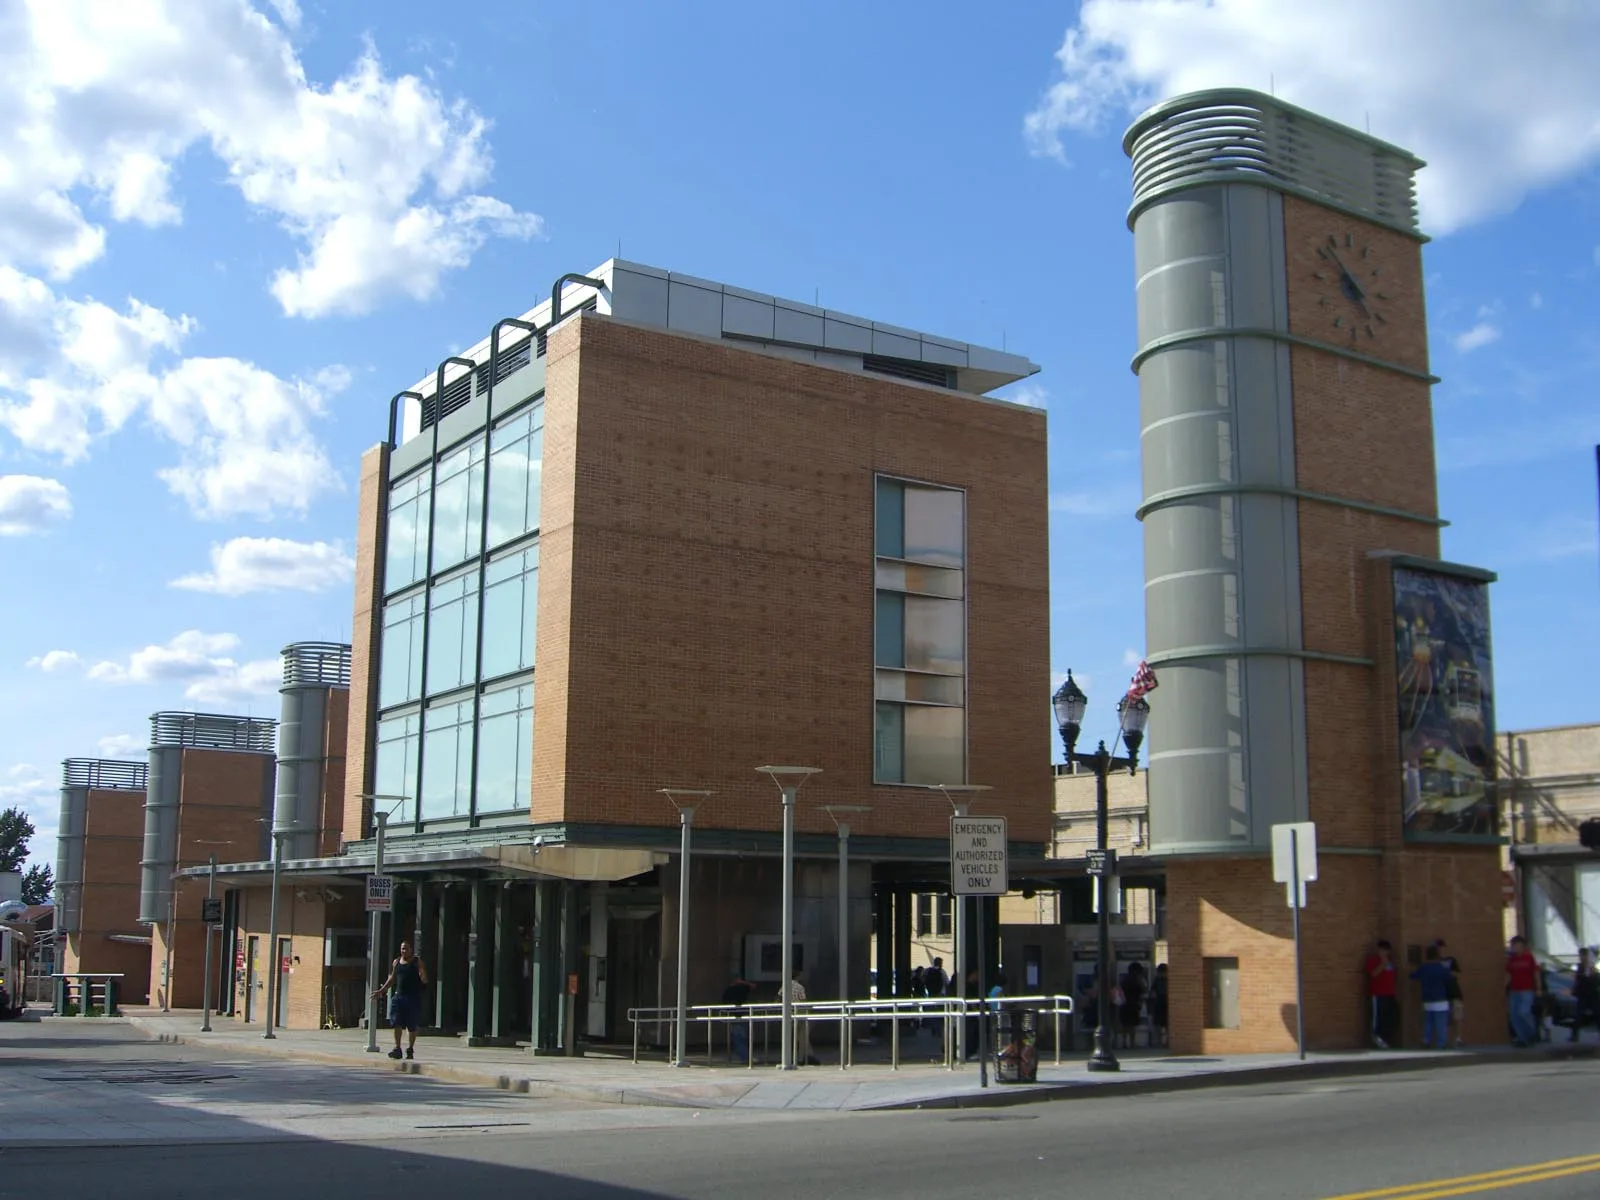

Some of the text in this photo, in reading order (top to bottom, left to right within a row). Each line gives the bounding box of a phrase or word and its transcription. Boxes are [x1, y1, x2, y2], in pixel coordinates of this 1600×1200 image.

[955, 823, 1002, 834] EMERGENCY
[971, 837, 988, 848] AND
[955, 850, 1004, 861] AUTHORIZED
[961, 864, 999, 875] VEHICLES
[369, 878, 391, 888] BUSES
[968, 877, 992, 888] ONLY
